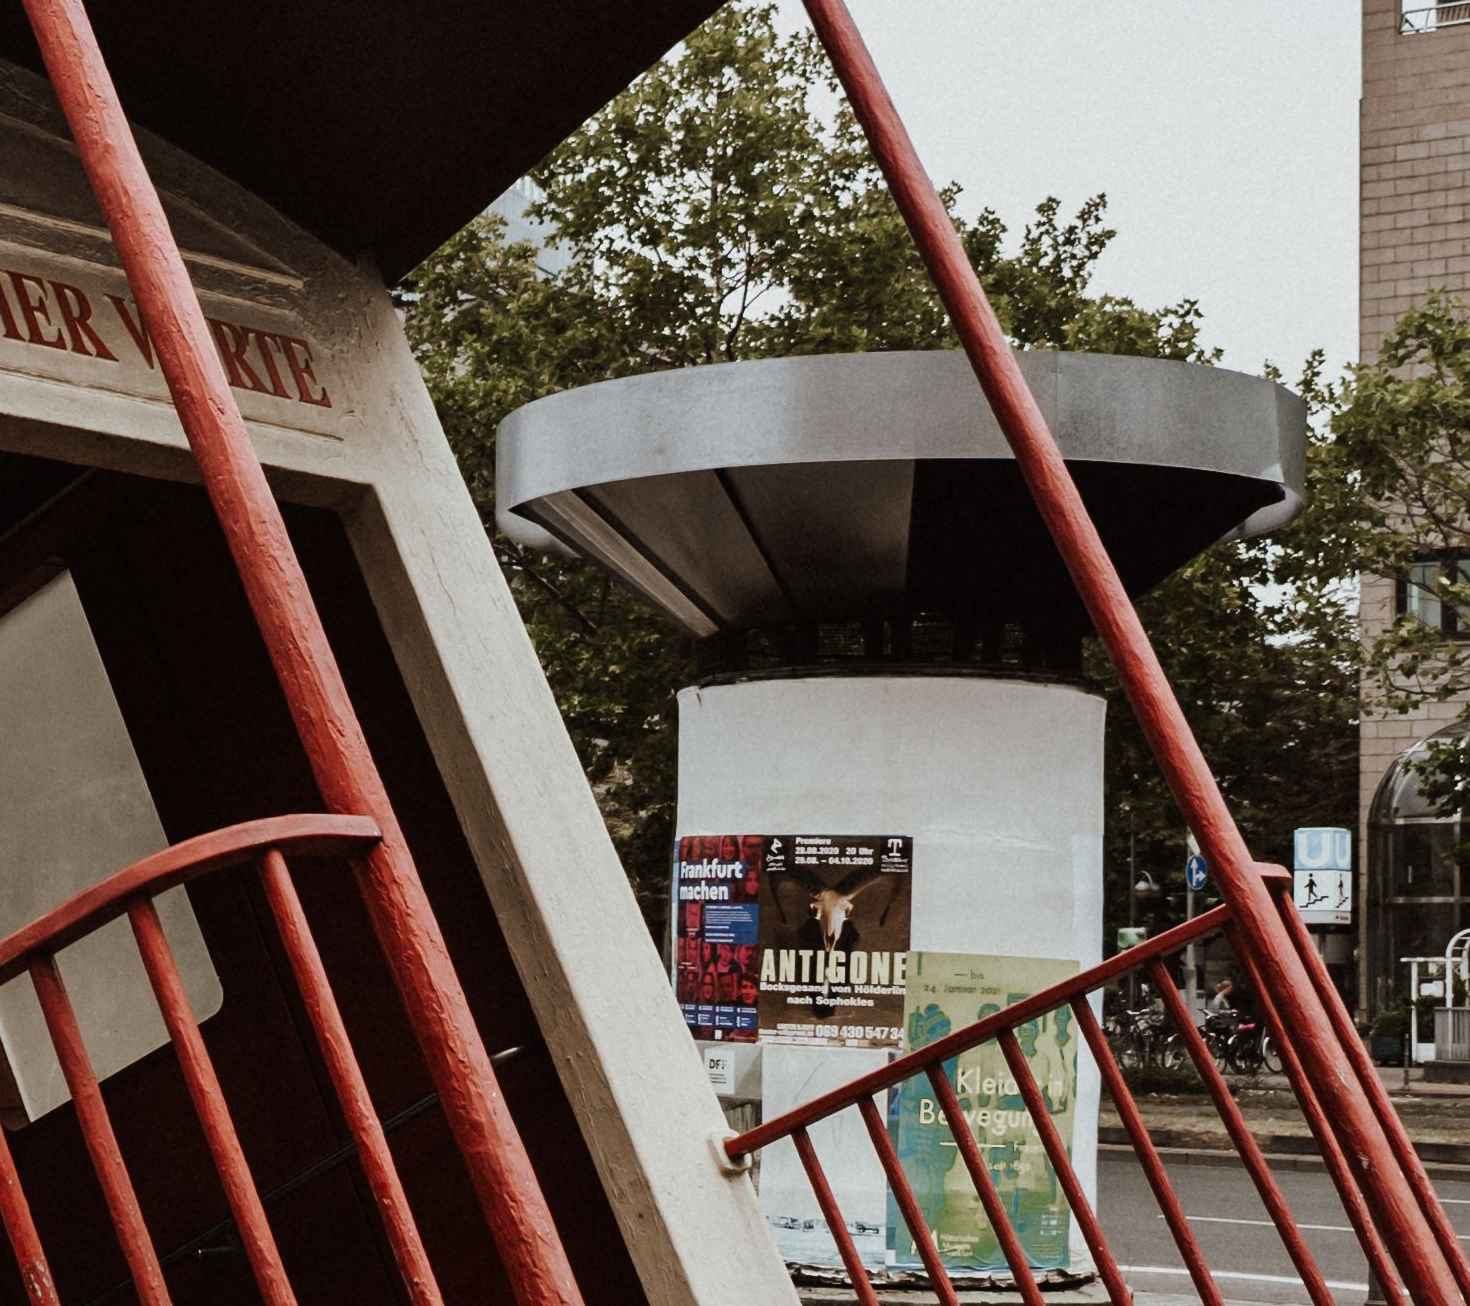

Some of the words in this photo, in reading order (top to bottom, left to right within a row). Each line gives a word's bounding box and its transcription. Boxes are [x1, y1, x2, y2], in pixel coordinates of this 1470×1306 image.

[858, 847, 874, 855] Uhr
[1298, 832, 1332, 868] U
[680, 858, 744, 879] Frankfurt
[679, 880, 730, 901] machen
[760, 948, 907, 986] ANTIGONE
[759, 981, 829, 994] Bocksgesang
[831, 984, 852, 994] von
[854, 981, 906, 995] Hölderlin
[786, 995, 813, 1005] nach
[815, 995, 875, 1007] Sophokles
[815, 1024, 839, 1038] 069
[840, 1025, 863, 1038] 430
[865, 1026, 889, 1039] 547
